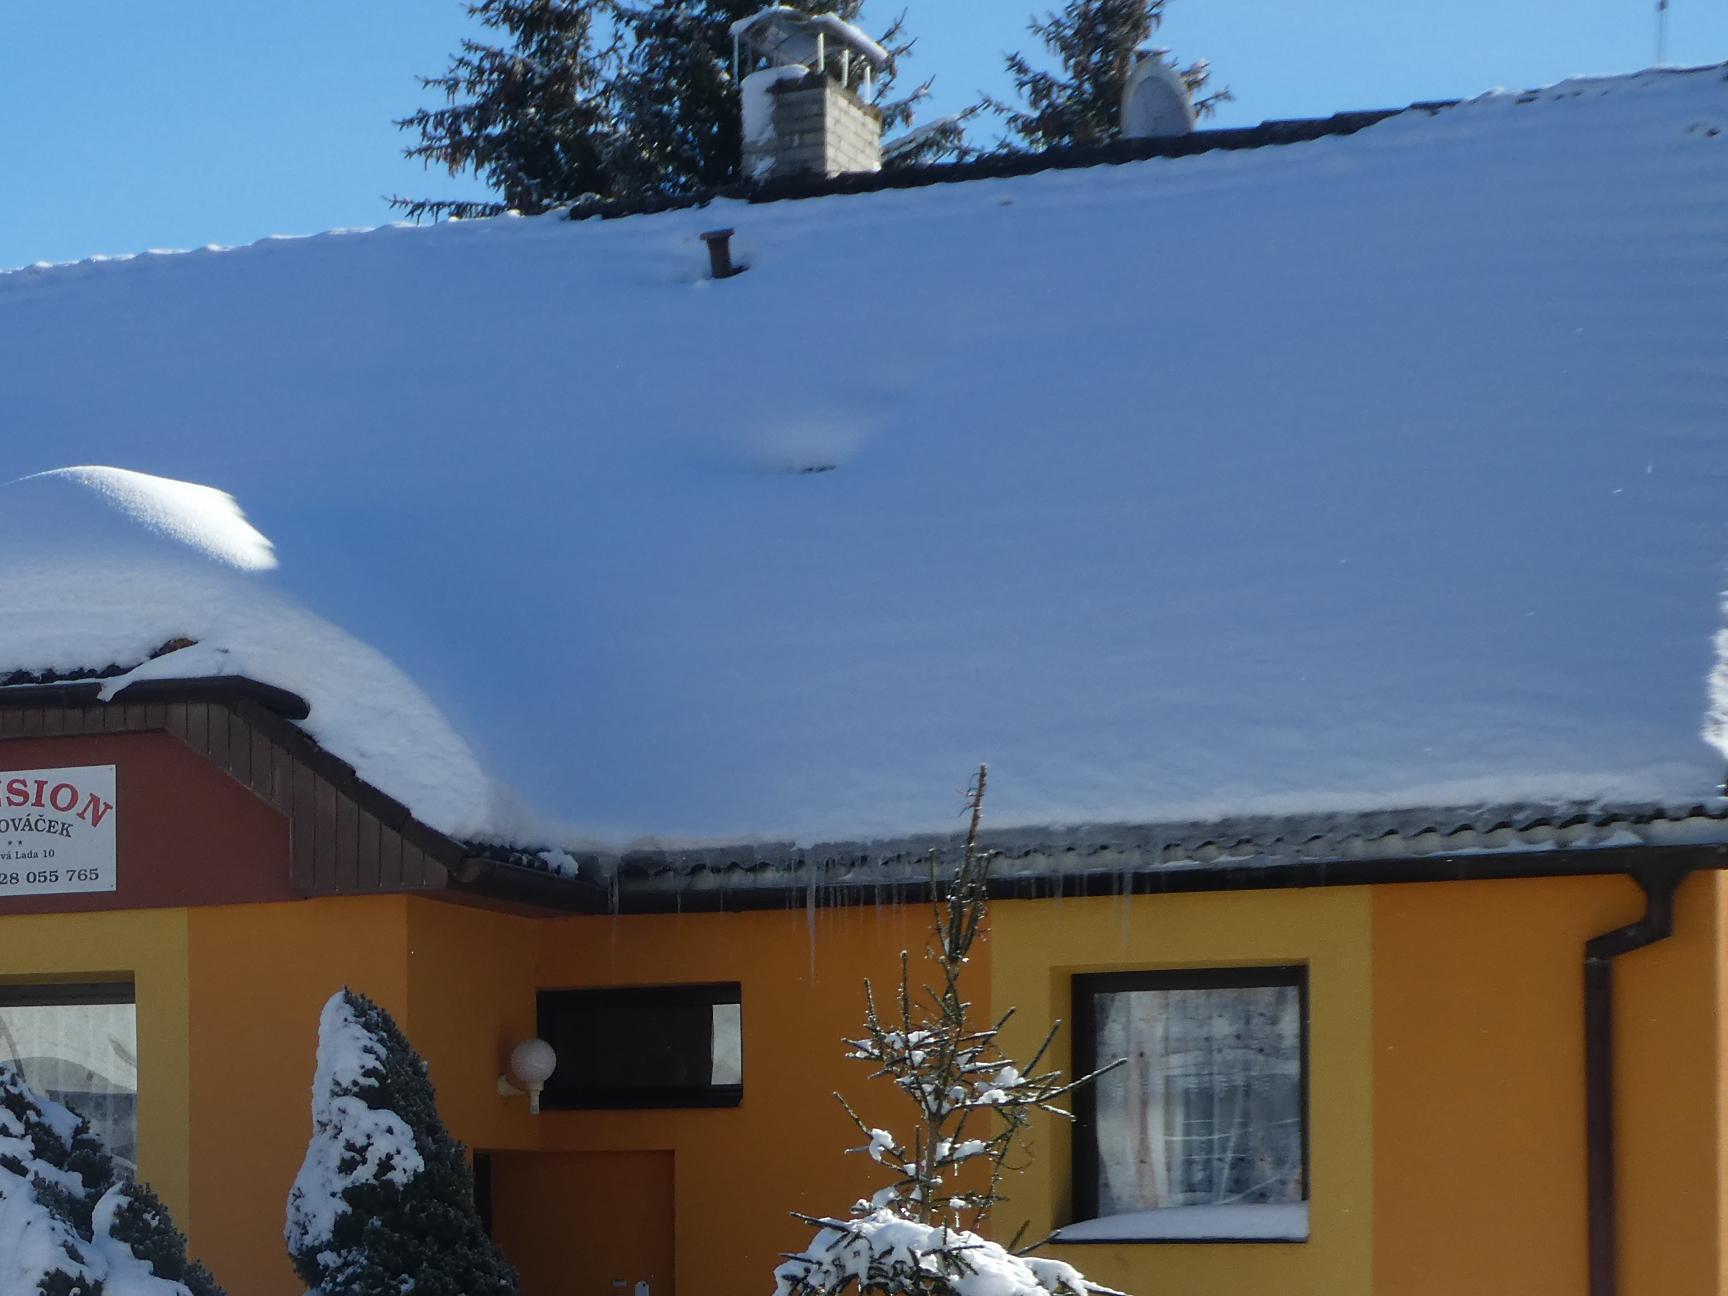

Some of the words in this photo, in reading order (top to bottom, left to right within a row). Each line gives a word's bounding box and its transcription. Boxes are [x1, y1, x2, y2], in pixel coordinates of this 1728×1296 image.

[15, 850, 39, 860] Lada
[43, 849, 55, 858] 10
[26, 869, 59, 884] 055
[66, 867, 100, 882] 765
